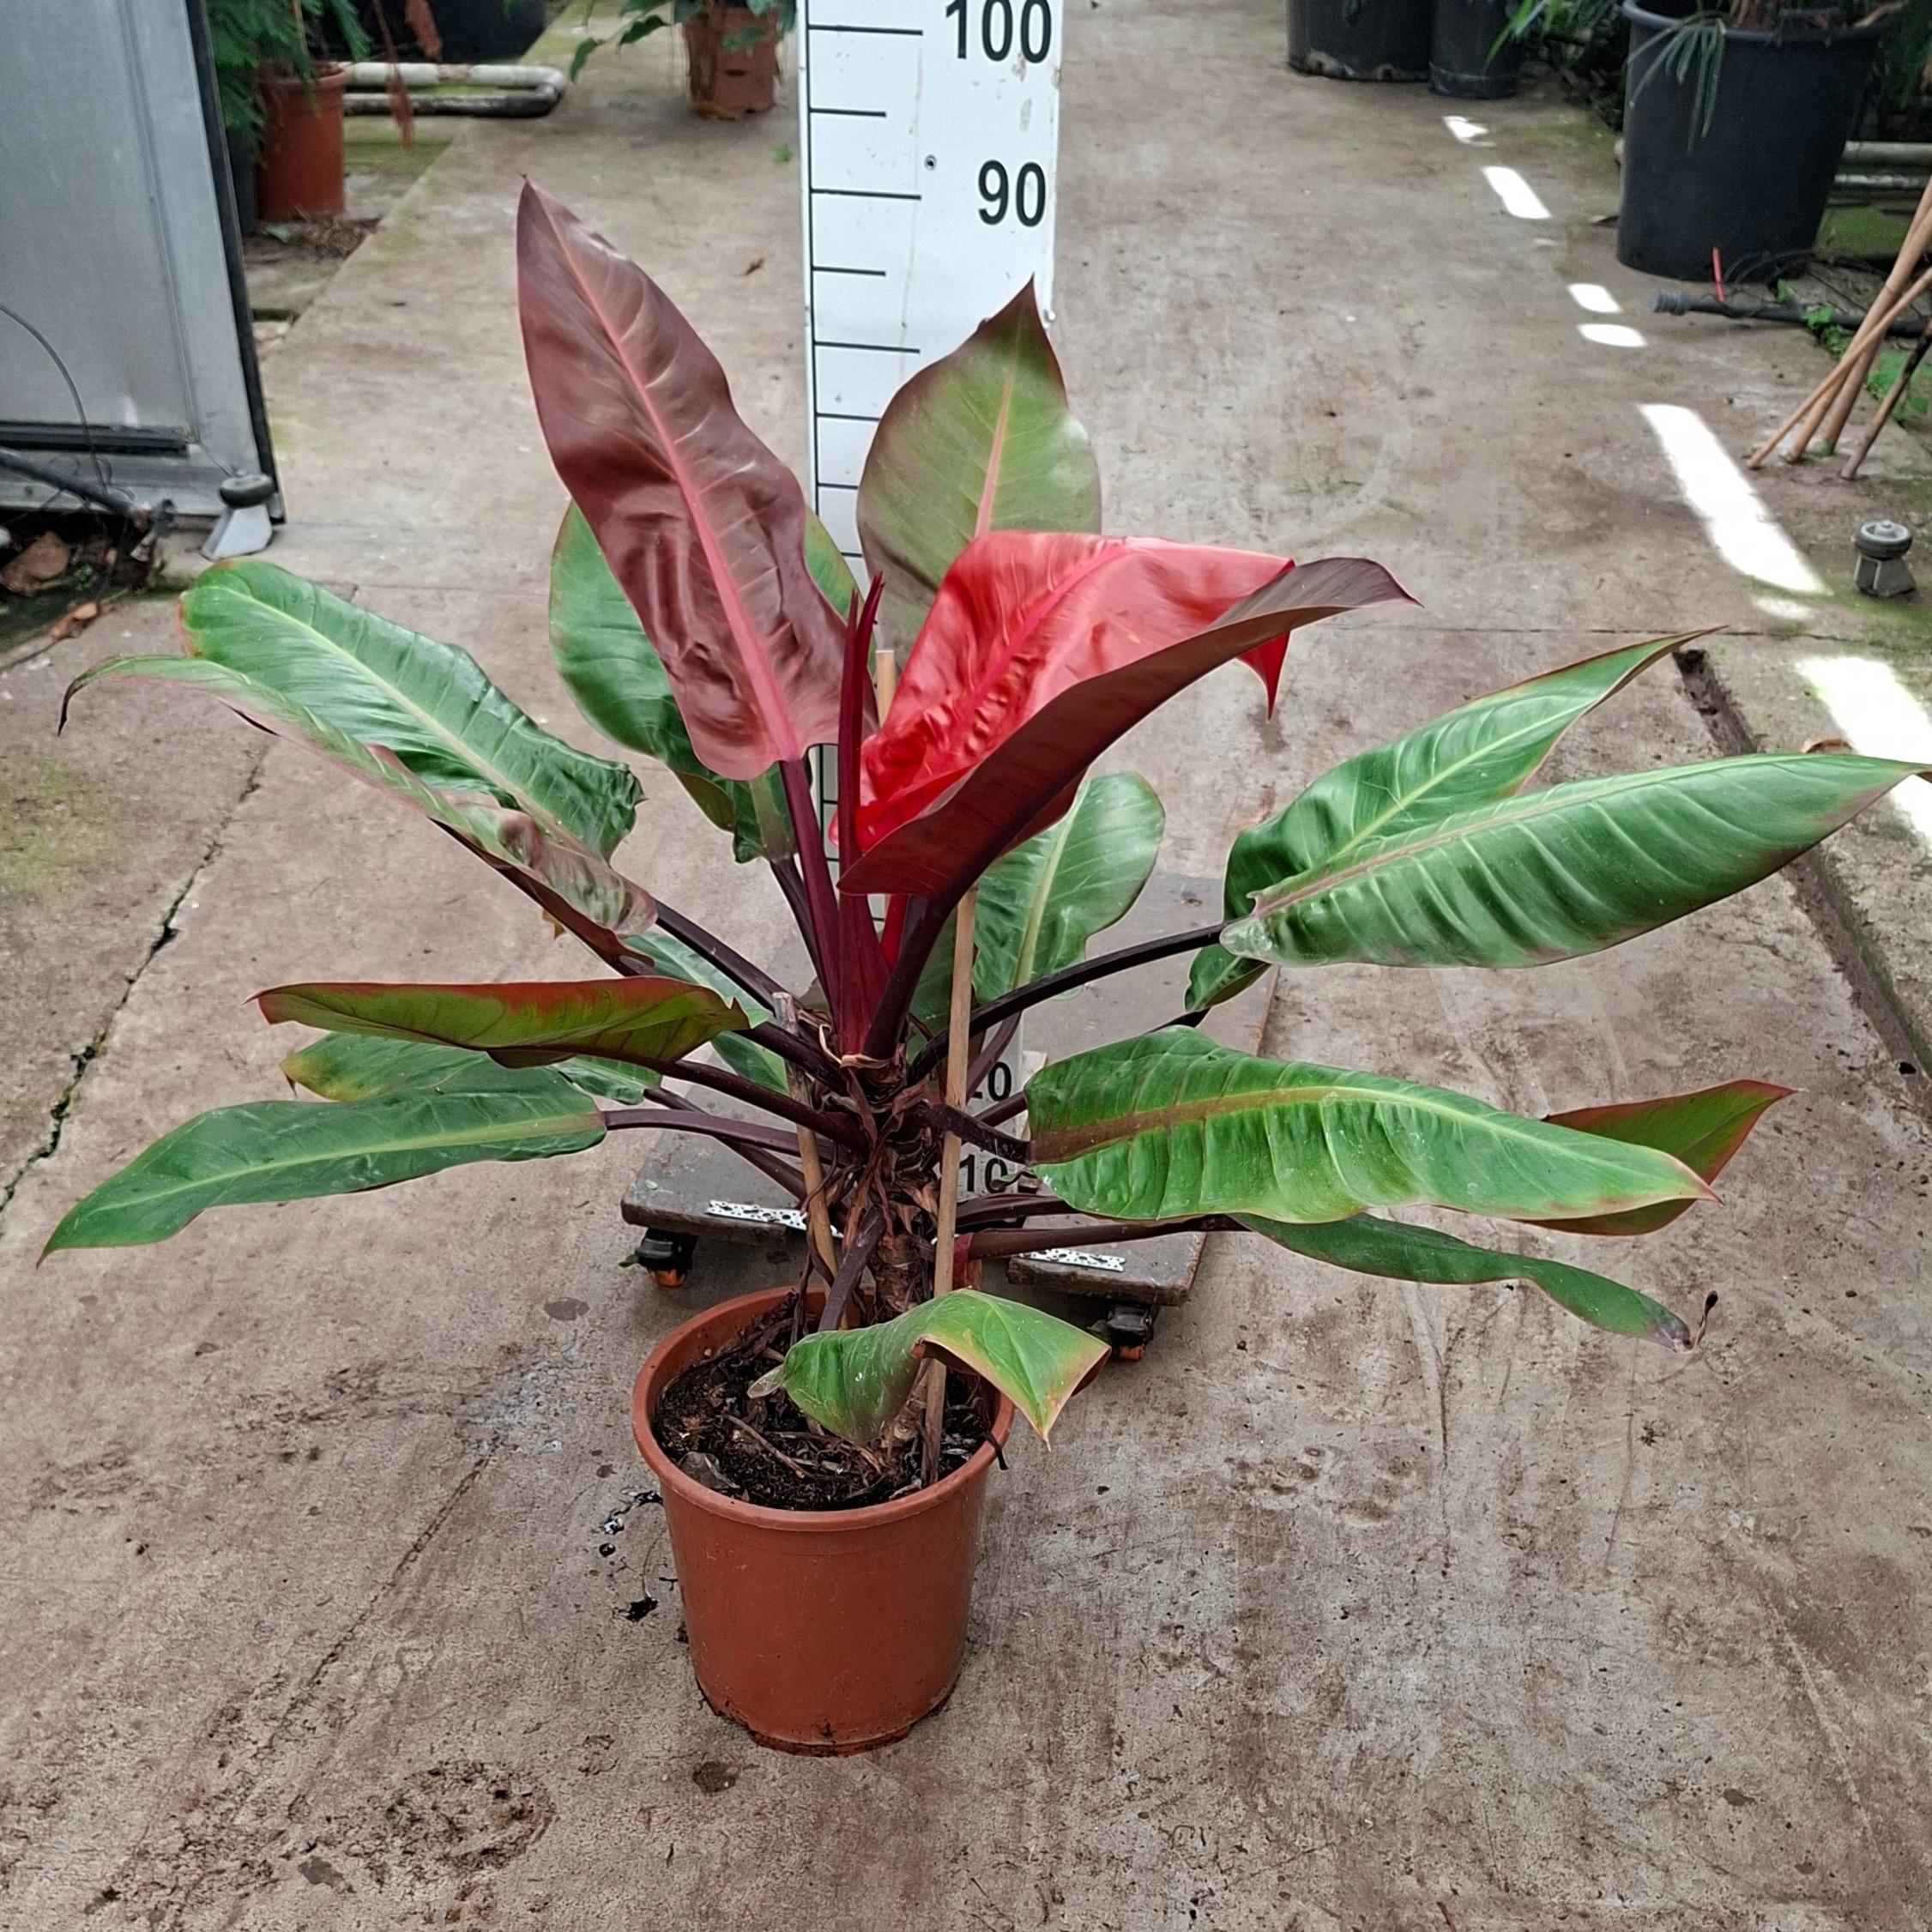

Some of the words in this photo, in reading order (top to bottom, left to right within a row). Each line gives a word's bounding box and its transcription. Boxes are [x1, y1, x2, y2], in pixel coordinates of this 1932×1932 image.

[945, 0, 1053, 64] 100
[978, 160, 1047, 227] 90
[972, 1061, 1012, 1102] 0
[959, 1154, 1009, 1193] 10
